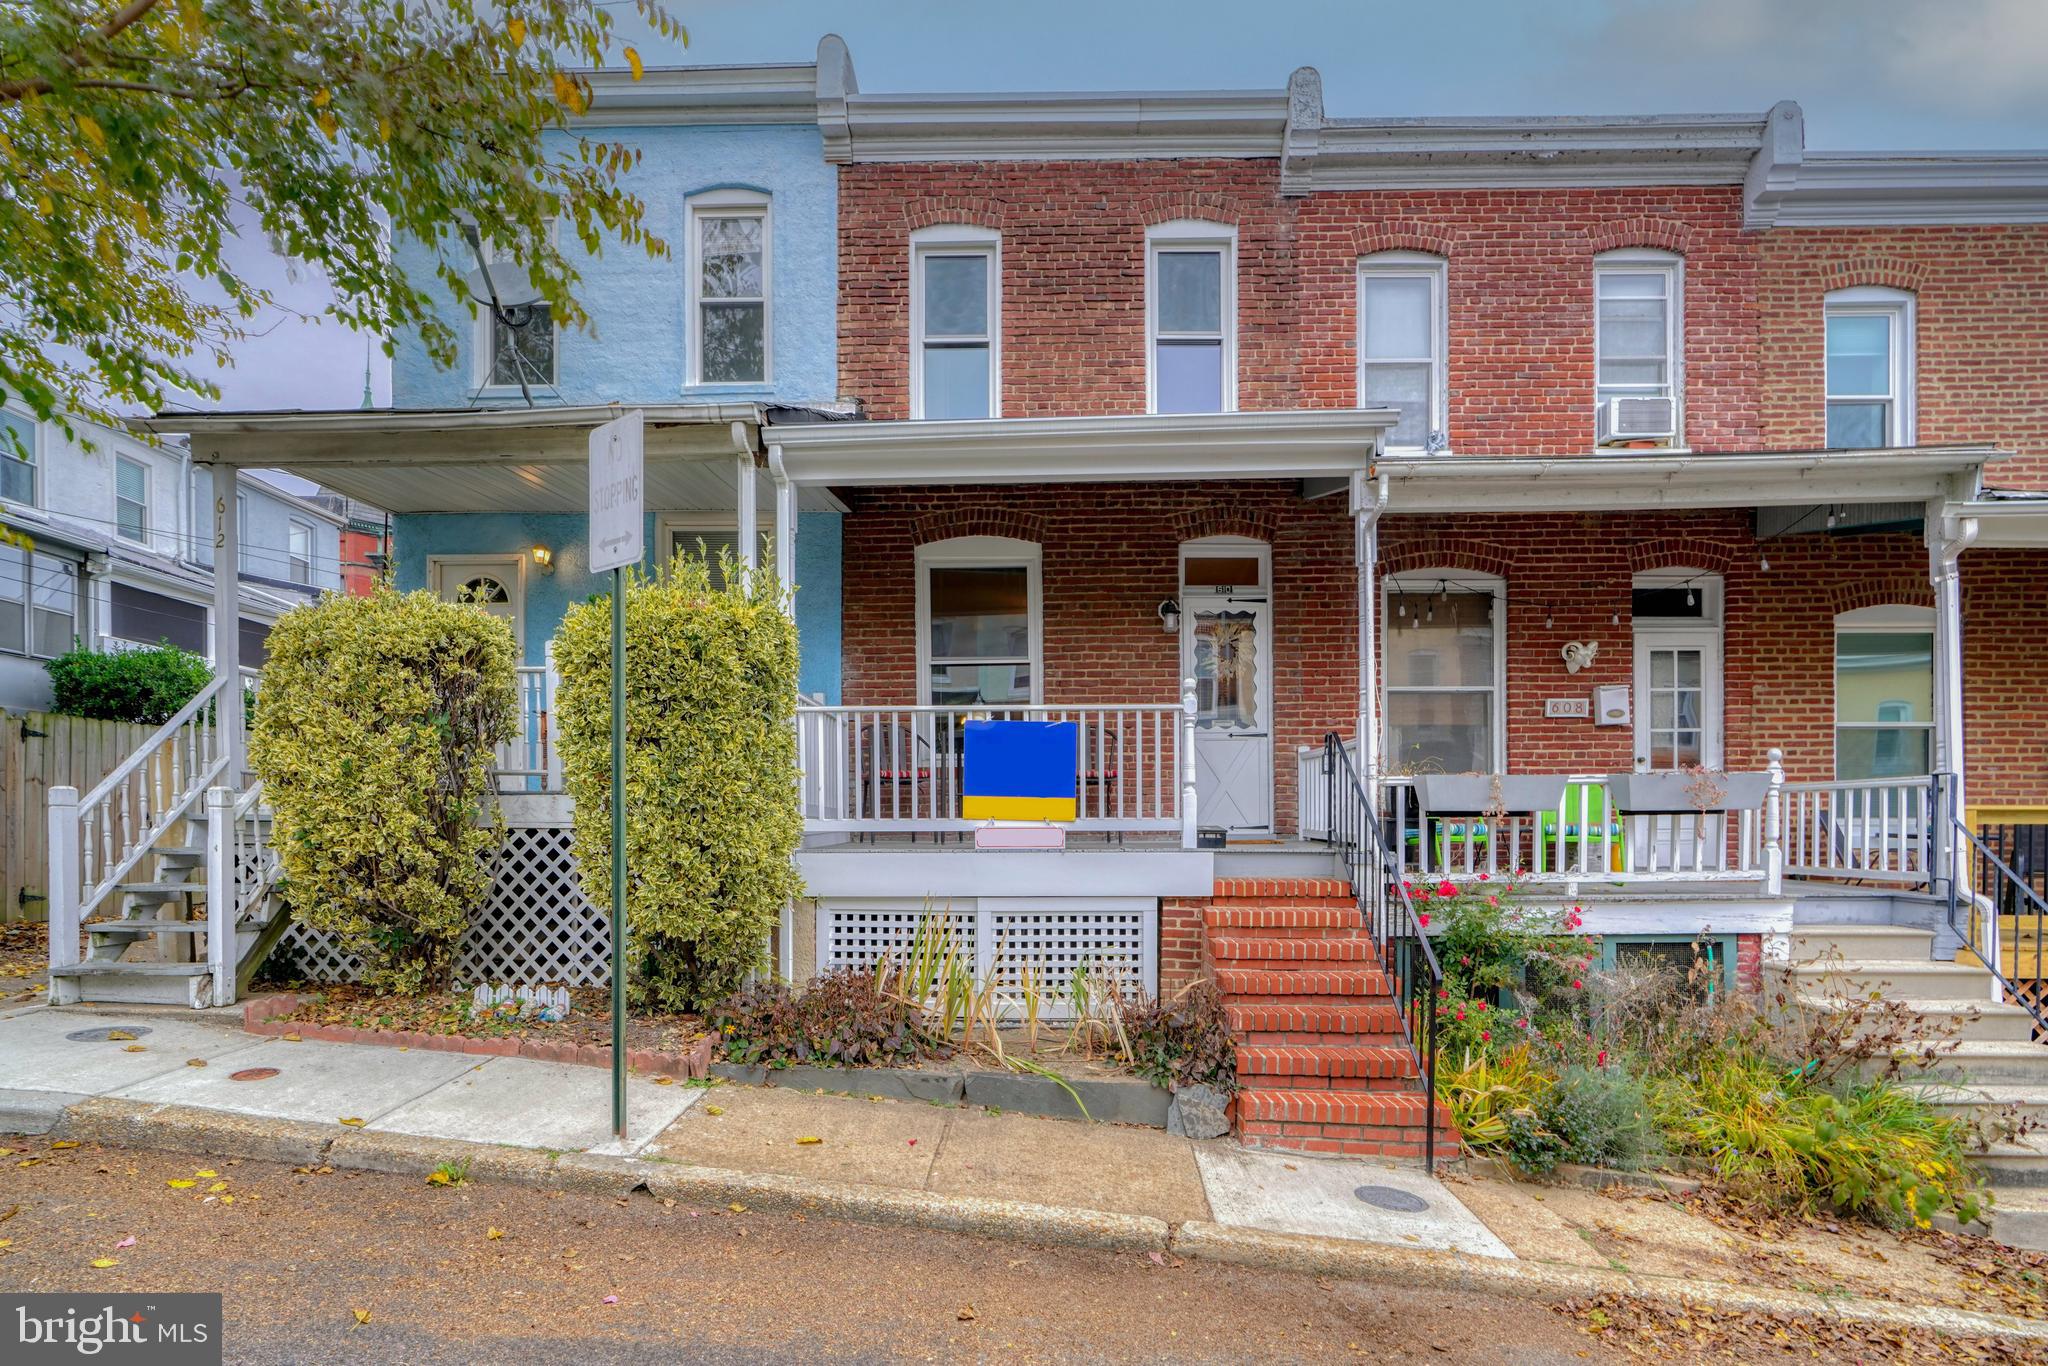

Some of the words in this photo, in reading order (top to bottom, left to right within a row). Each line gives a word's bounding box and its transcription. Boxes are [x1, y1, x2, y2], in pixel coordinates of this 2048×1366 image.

[607, 436, 623, 464] NO
[593, 475, 638, 515] STOPPING
[216, 496, 226, 548] 612
[1552, 702, 1583, 714] 608
